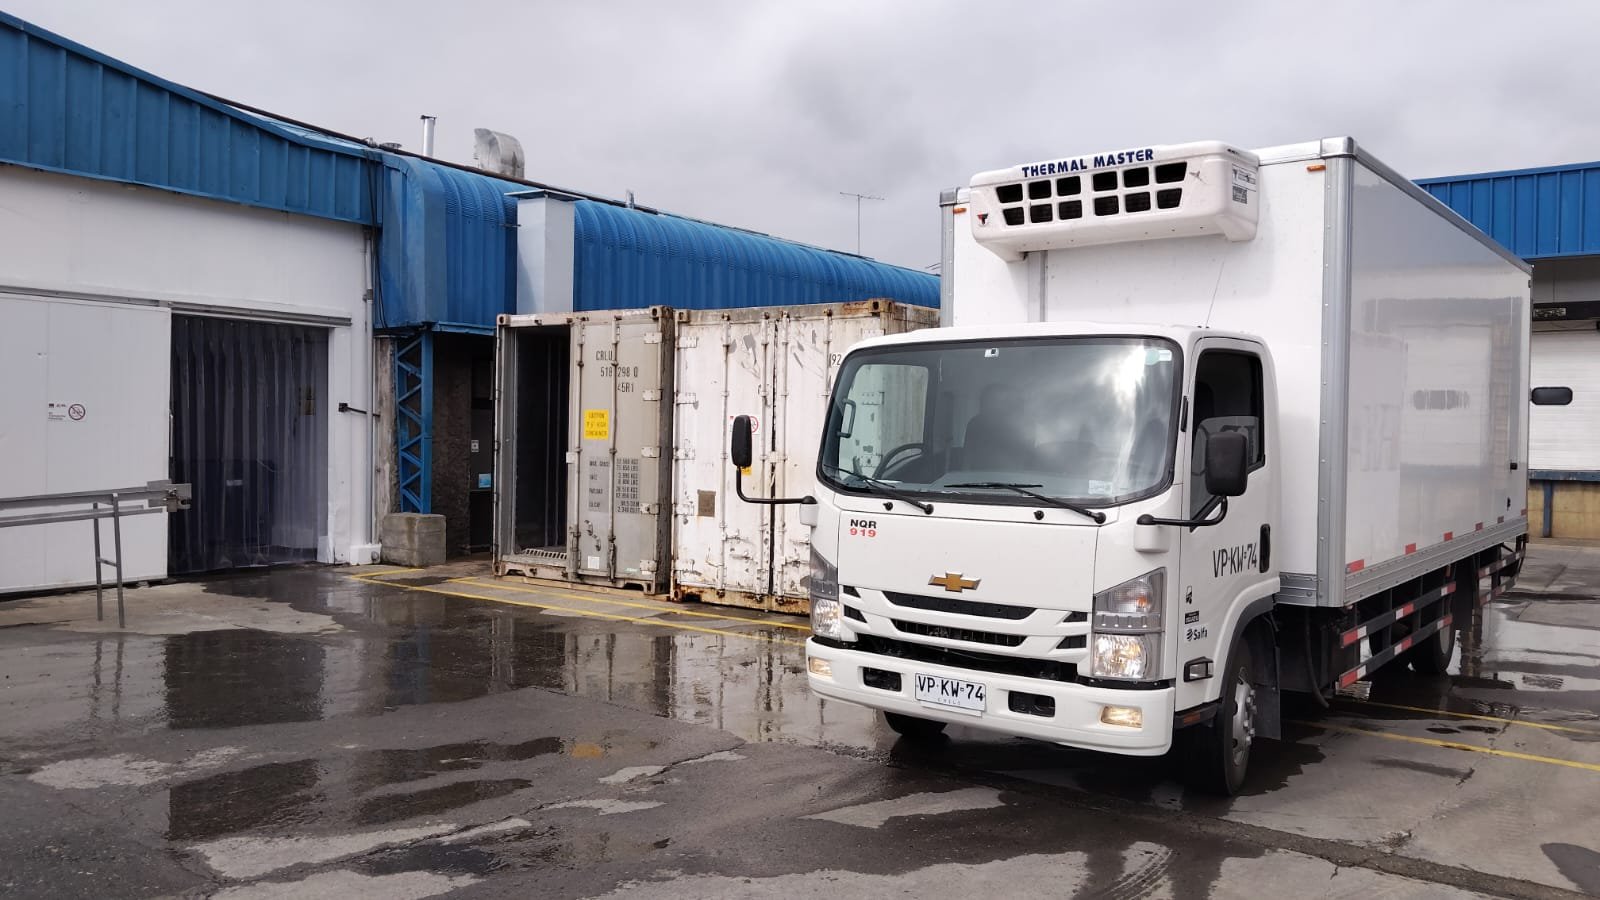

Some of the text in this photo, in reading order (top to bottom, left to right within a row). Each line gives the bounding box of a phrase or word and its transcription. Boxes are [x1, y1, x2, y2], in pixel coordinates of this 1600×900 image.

[1022, 149, 1154, 177] THERMAL MASTER
[850, 519, 877, 529] NQR
[850, 527, 876, 538] 919
